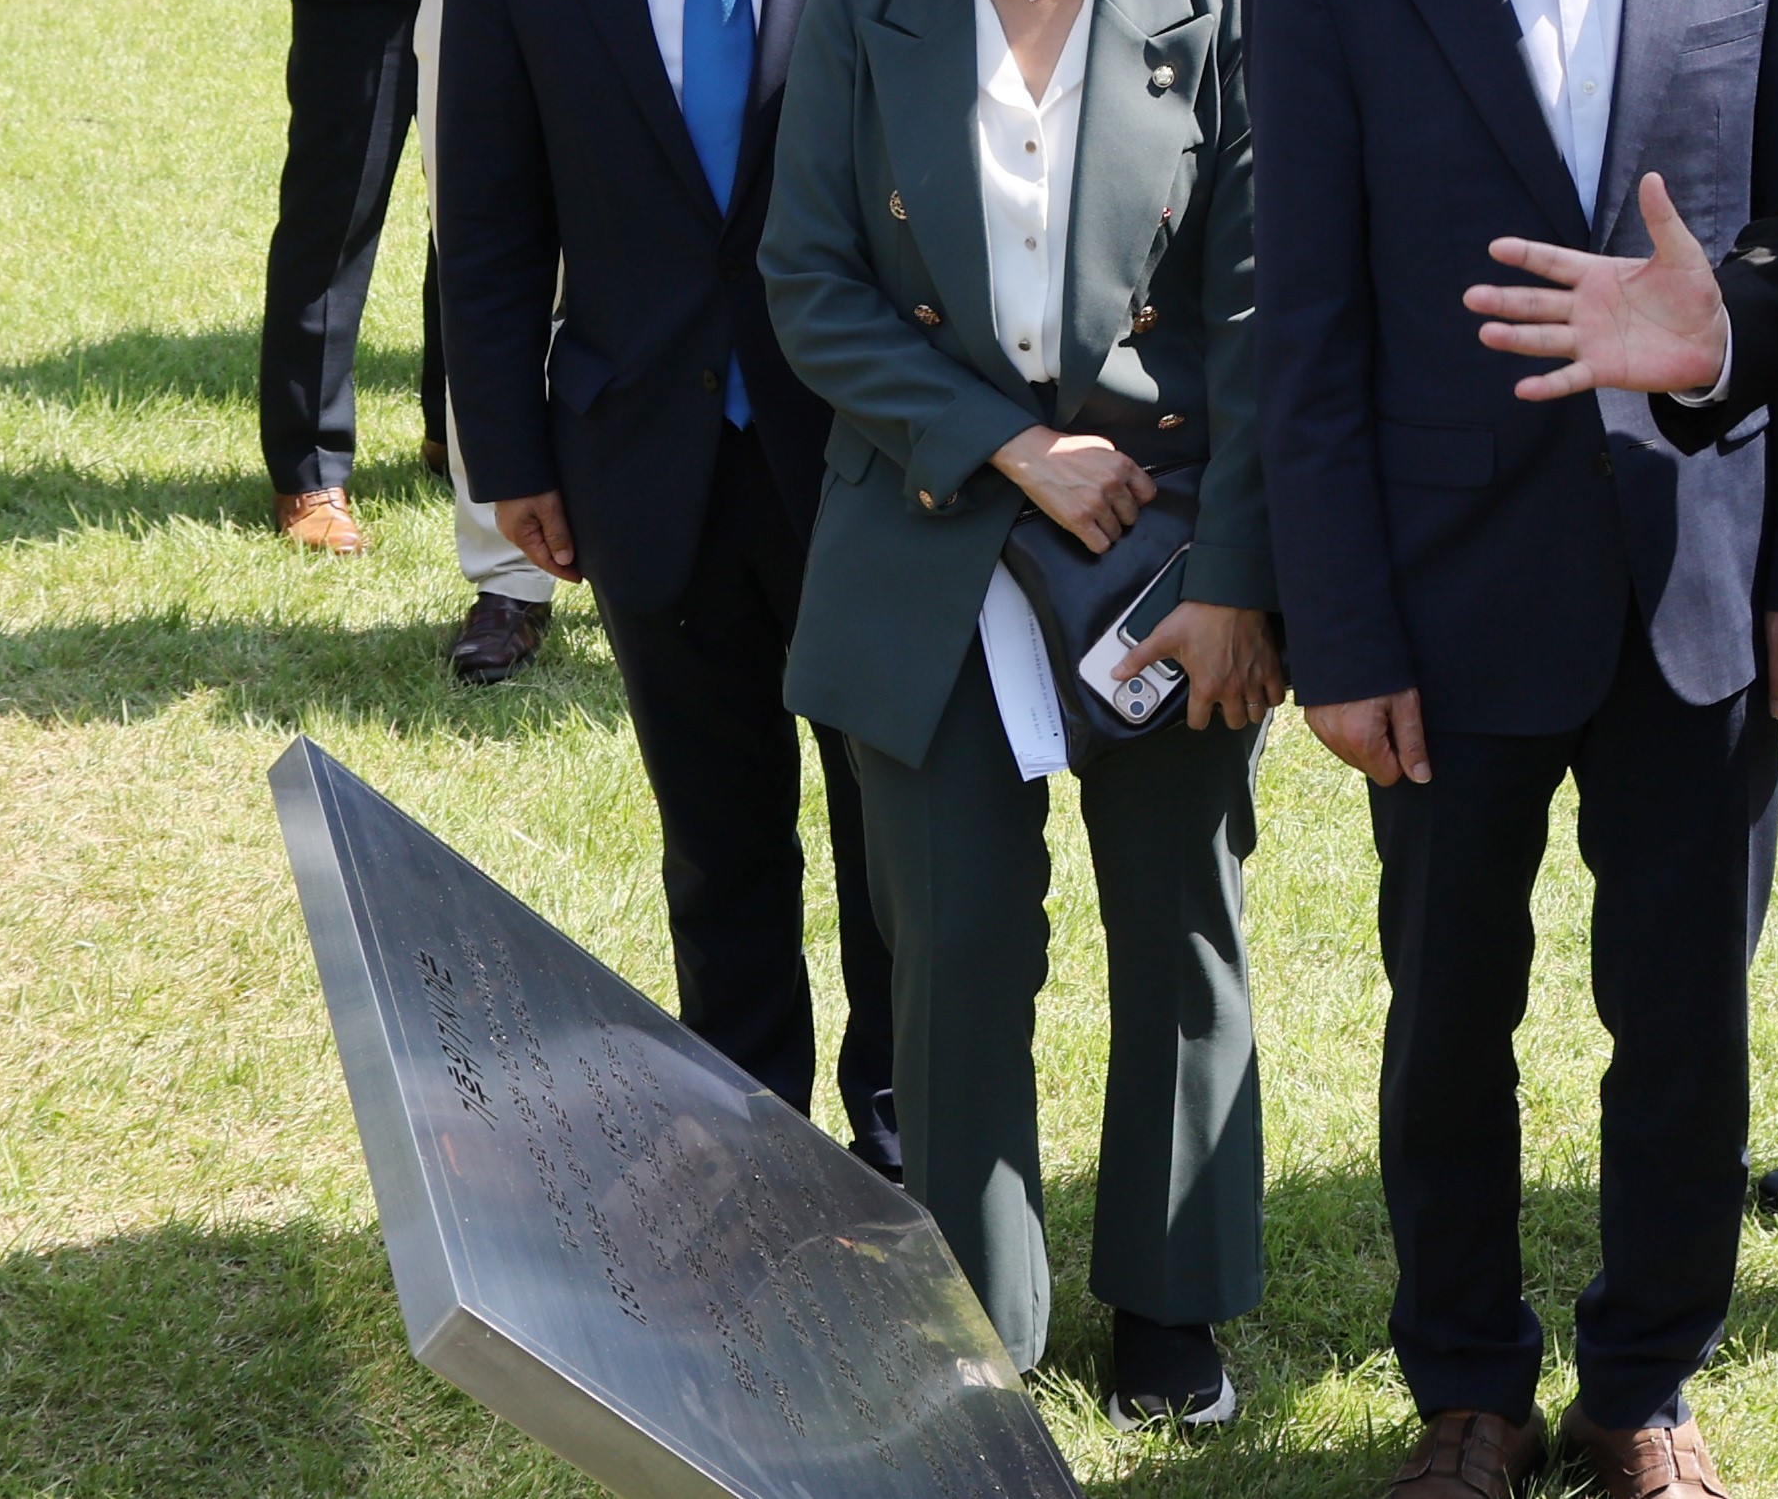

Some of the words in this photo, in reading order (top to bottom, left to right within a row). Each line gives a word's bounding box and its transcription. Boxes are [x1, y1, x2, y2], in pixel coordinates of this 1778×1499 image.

[417, 950, 499, 1131] 기후위기시계는
[524, 1046, 556, 1093] 시간을
[583, 1199, 625, 1269] 상승하는
